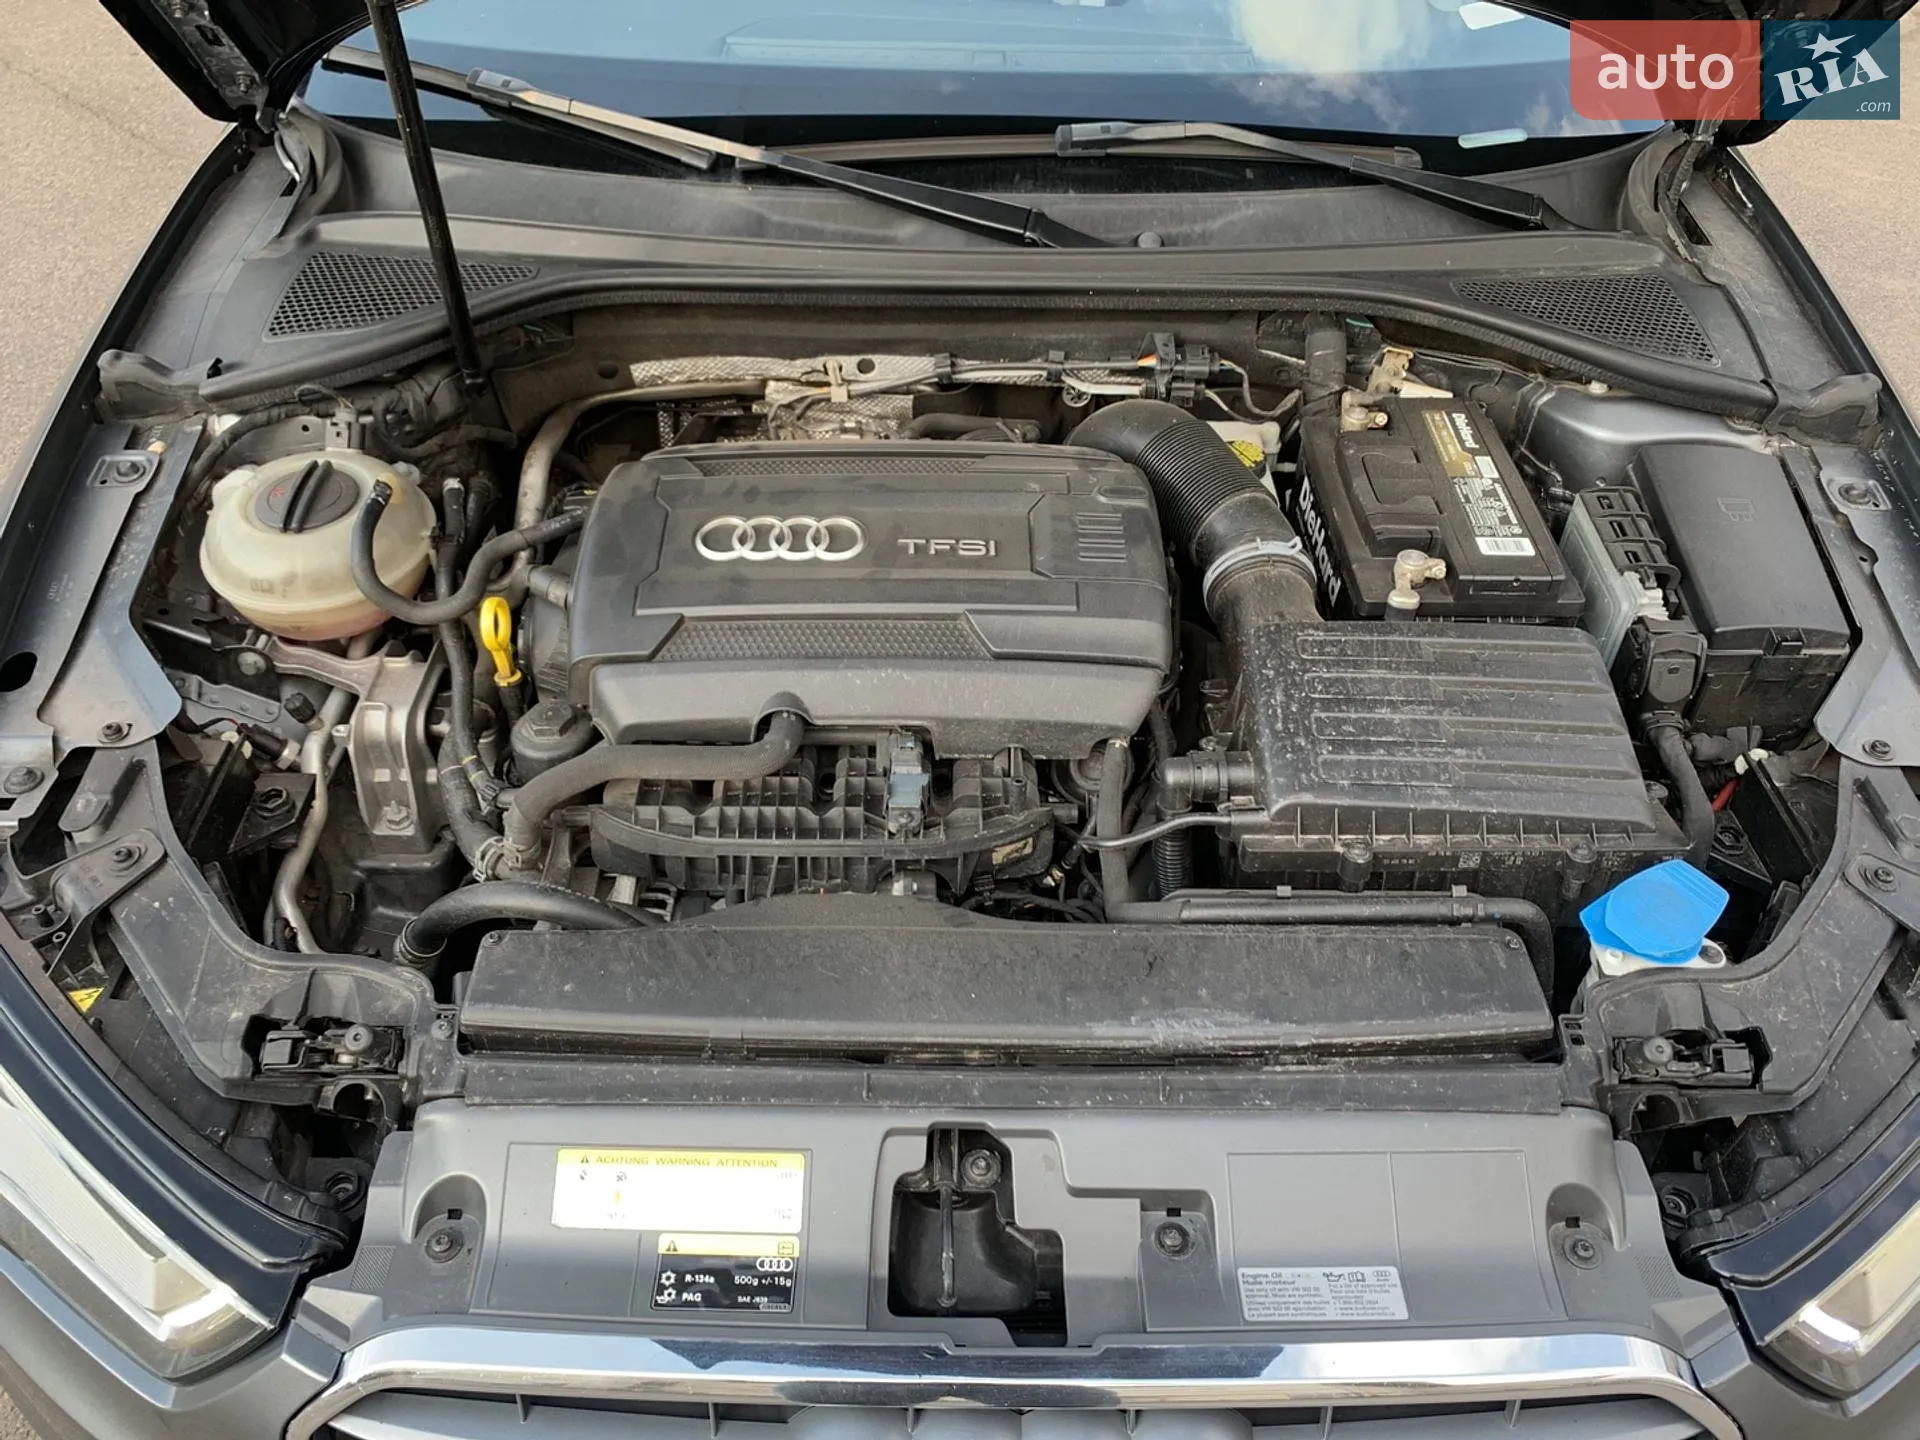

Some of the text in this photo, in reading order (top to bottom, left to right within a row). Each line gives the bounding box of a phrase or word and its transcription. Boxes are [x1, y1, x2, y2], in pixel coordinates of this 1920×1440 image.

[897, 537, 998, 557] TFSI
[1299, 476, 1341, 608] DieHard
[596, 1155, 778, 1168] ACHTUNG WARNING ATTENTION
[734, 1275, 759, 1286] 500g
[774, 1276, 792, 1287] 15g
[681, 1292, 702, 1302] PAG
